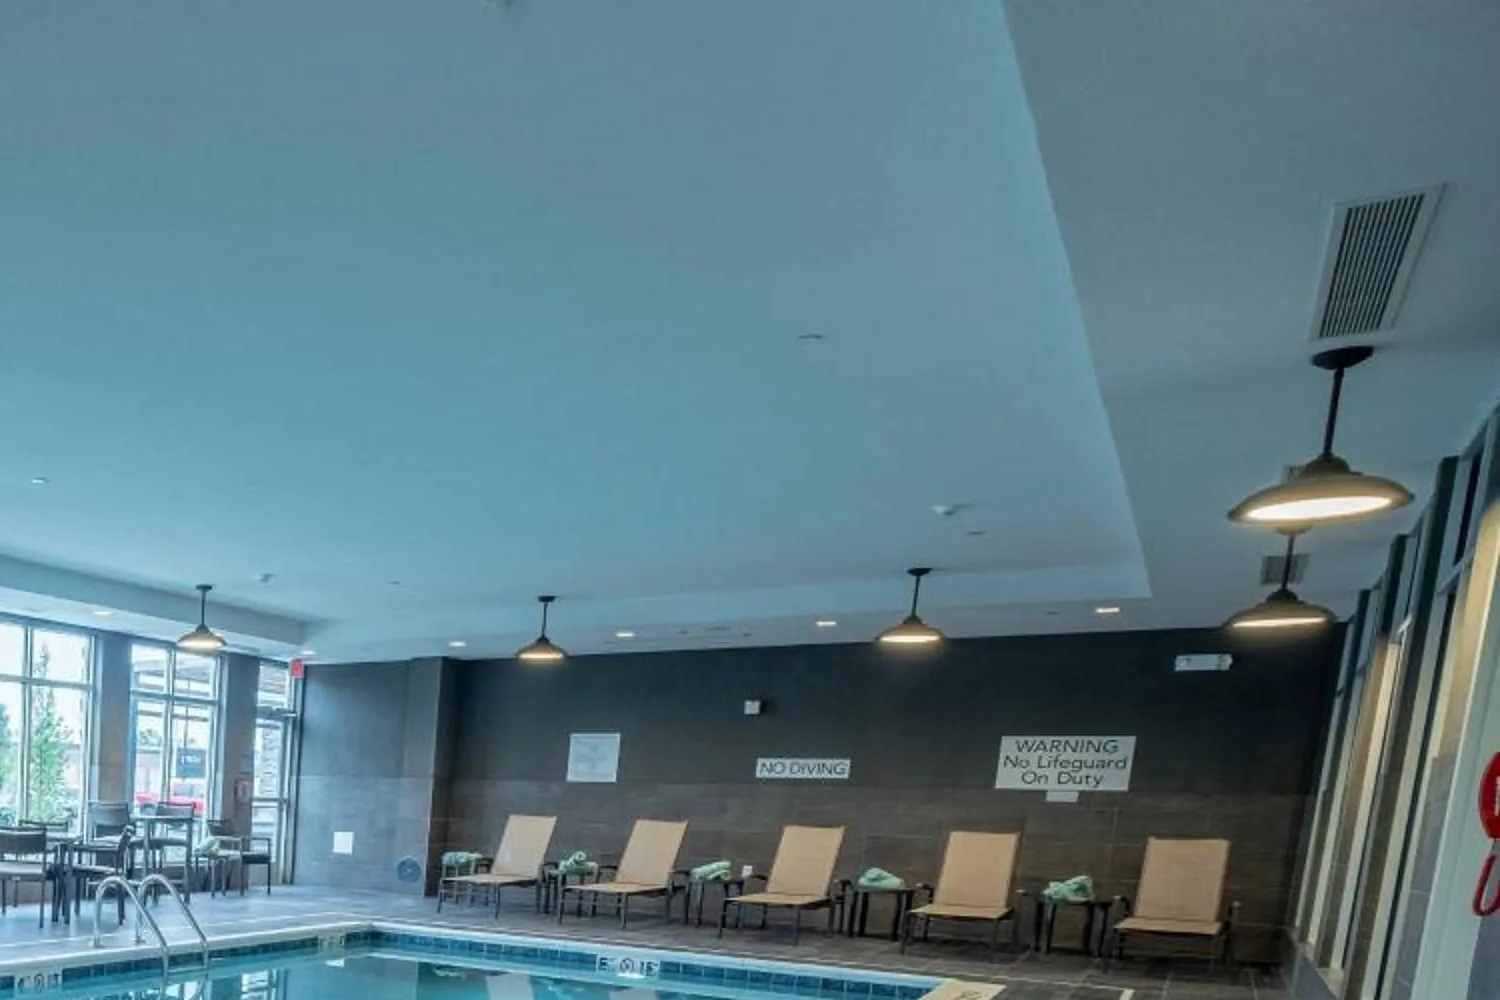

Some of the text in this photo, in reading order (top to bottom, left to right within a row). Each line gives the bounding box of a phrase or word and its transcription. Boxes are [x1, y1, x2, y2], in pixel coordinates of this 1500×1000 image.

[1015, 739, 1120, 754] WARNING
[760, 762, 849, 775] NO DIVING
[1003, 755, 1128, 772] No Lifeguard
[1021, 771, 1105, 788] On Duty
